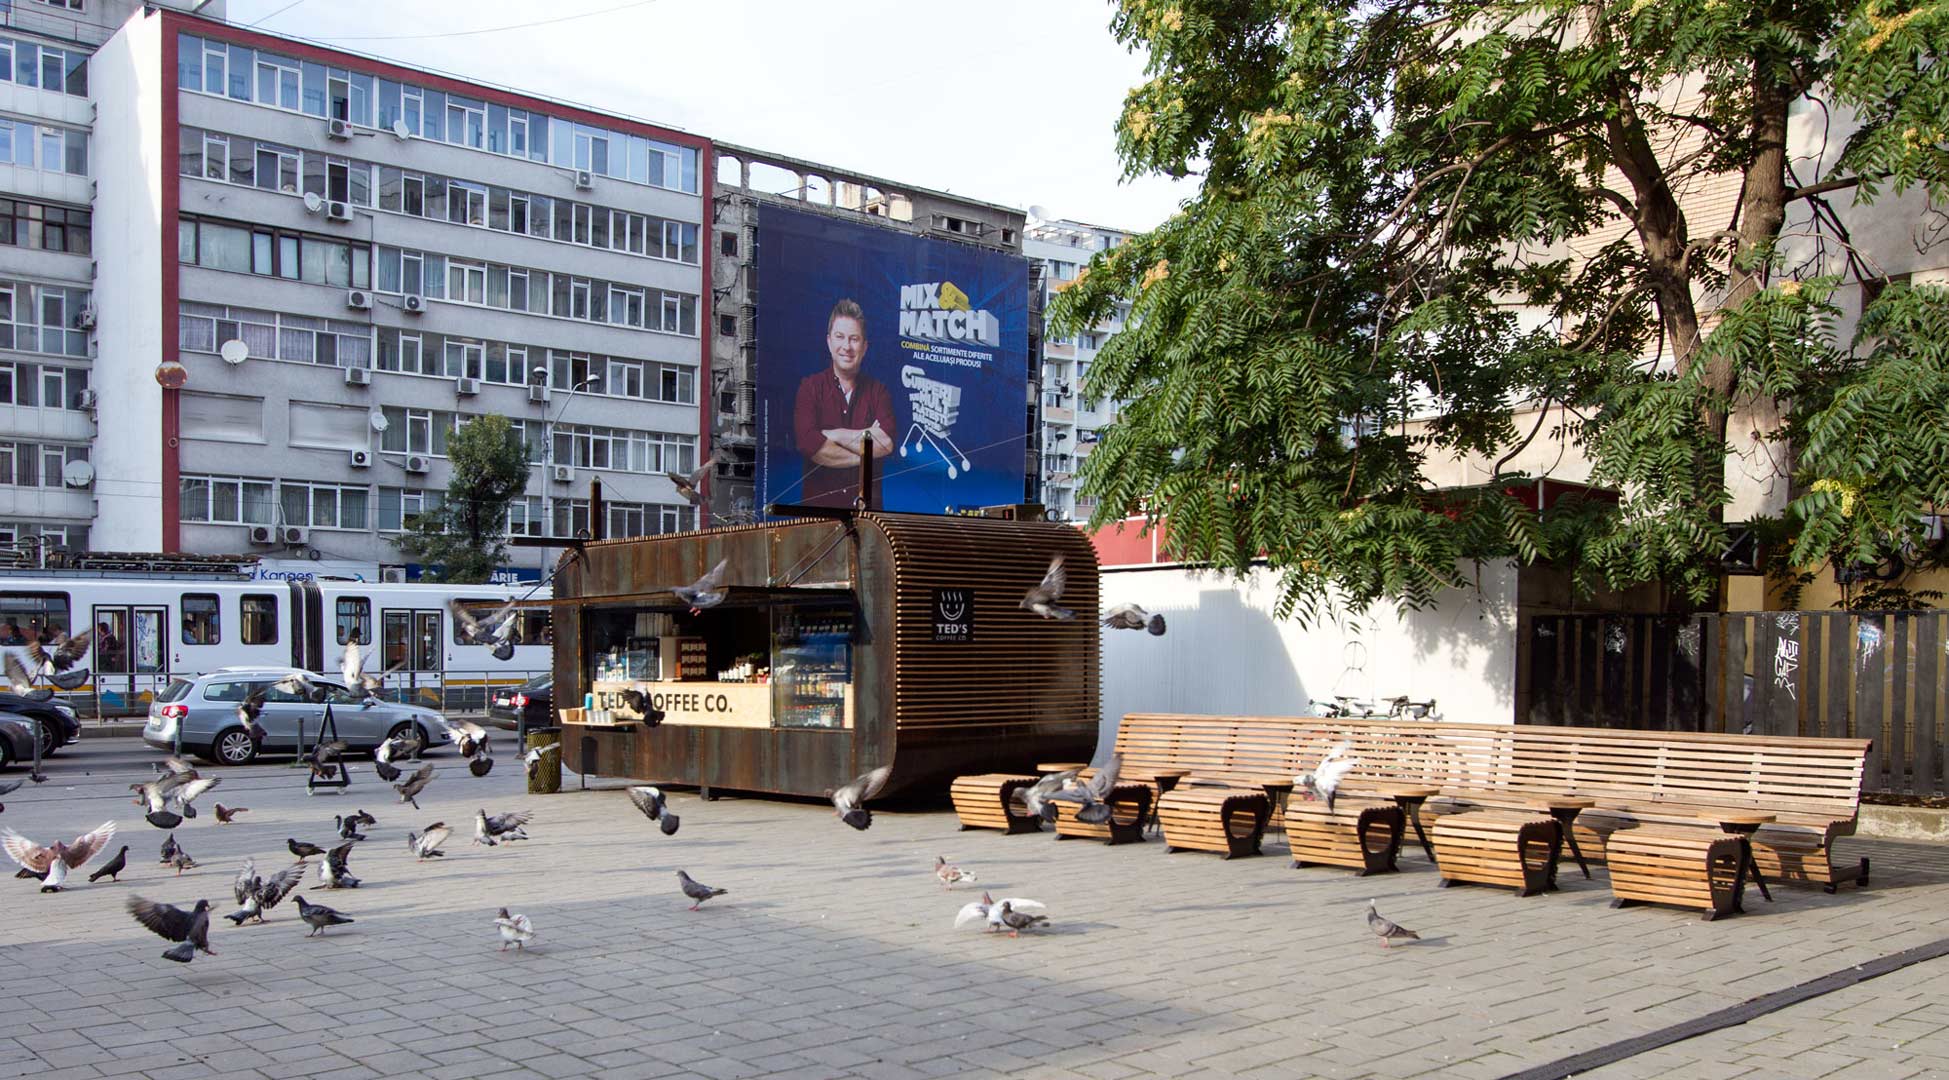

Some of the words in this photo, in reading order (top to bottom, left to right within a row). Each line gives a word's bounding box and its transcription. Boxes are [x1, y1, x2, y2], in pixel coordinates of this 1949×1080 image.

[900, 283, 939, 310] MIX
[899, 309, 993, 344] MATCH
[913, 351, 925, 360] ALE
[930, 345, 967, 358] SORTIMENTE
[968, 350, 993, 362] DIFERITE
[936, 623, 968, 634] TED'S
[597, 691, 627, 709] TED
[652, 692, 700, 712] OFFEE
[704, 694, 733, 713] CO.
